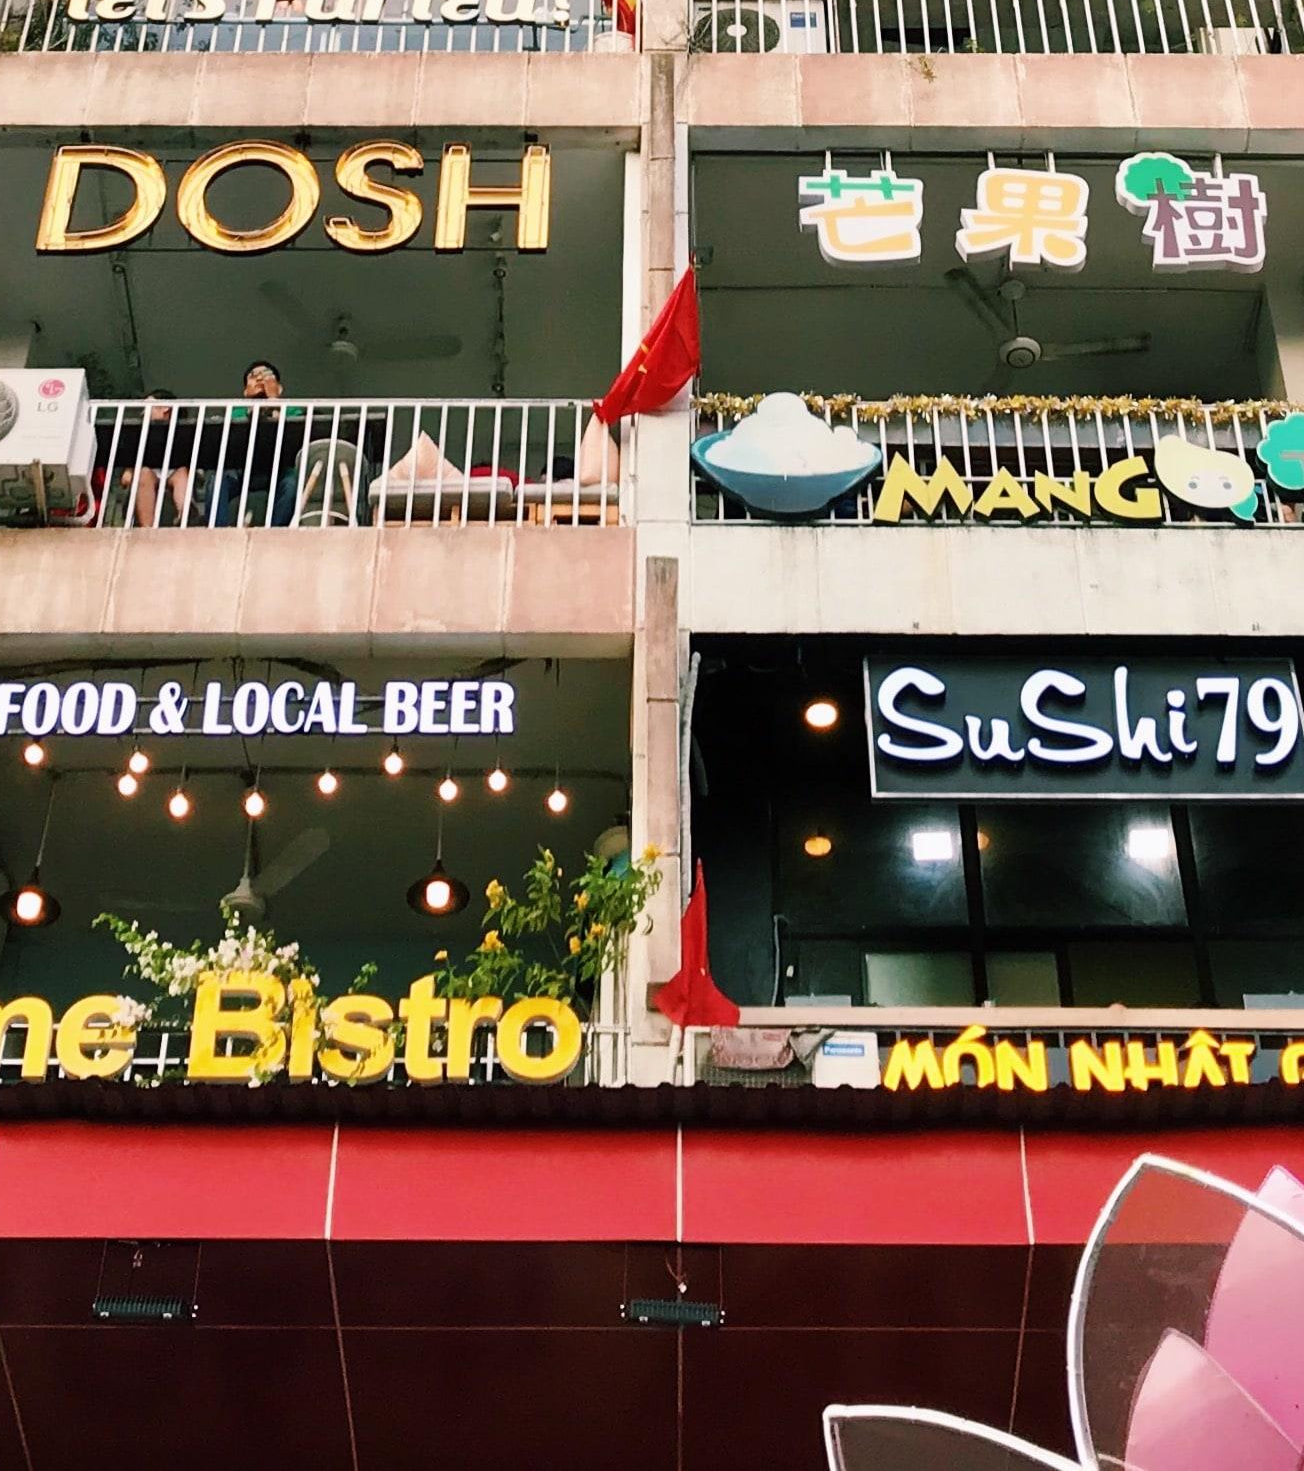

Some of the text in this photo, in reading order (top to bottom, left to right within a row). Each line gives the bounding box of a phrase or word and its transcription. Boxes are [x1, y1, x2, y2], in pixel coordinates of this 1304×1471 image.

[35, 140, 552, 254] DOSH
[800, 161, 1268, 274] 芒果樹
[36, 401, 60, 413] LG
[148, 680, 189, 735] &
[202, 680, 369, 735] LOCAL
[382, 680, 517, 735] BEER
[186, 972, 583, 1085] Bistro
[883, 1024, 1048, 1092] MÓN
